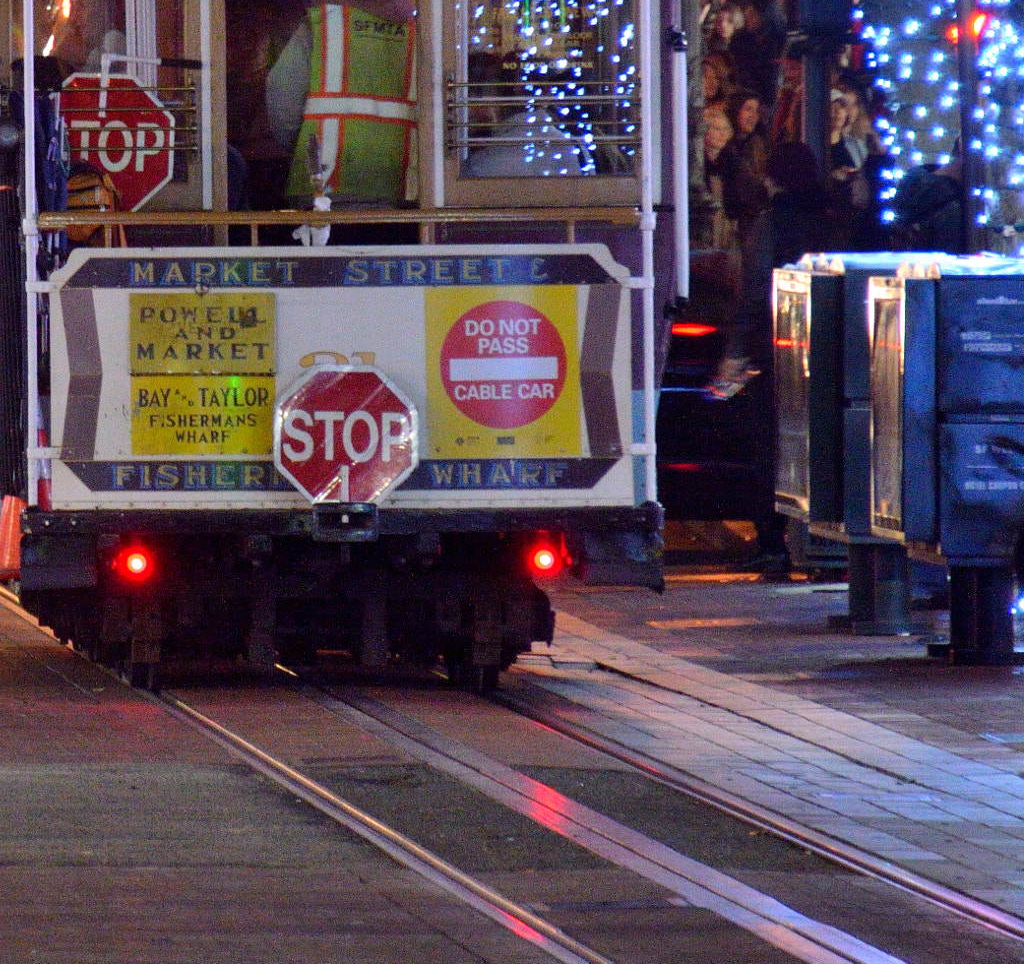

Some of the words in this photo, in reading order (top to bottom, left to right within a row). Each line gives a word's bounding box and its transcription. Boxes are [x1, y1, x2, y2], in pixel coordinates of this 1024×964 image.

[354, 20, 405, 37] SFMTA
[62, 120, 165, 173] TOP
[130, 261, 299, 285] MARKET
[344, 257, 511, 284] STREET
[139, 306, 266, 325] POWELL
[174, 326, 237, 341] AND
[464, 319, 495, 336] DO
[499, 318, 542, 335] NOT
[136, 343, 270, 361] MARKET
[478, 337, 529, 355] PASS
[138, 388, 171, 408] BAY
[197, 387, 269, 408] TAYLOR
[454, 384, 512, 401] CABLE
[518, 383, 555, 400] CAR
[149, 414, 257, 428] FISHERMANS
[175, 431, 231, 444] WHARF
[283, 409, 411, 463] STOP
[113, 464, 282, 489] FISHER
[429, 460, 568, 487] WHARF
